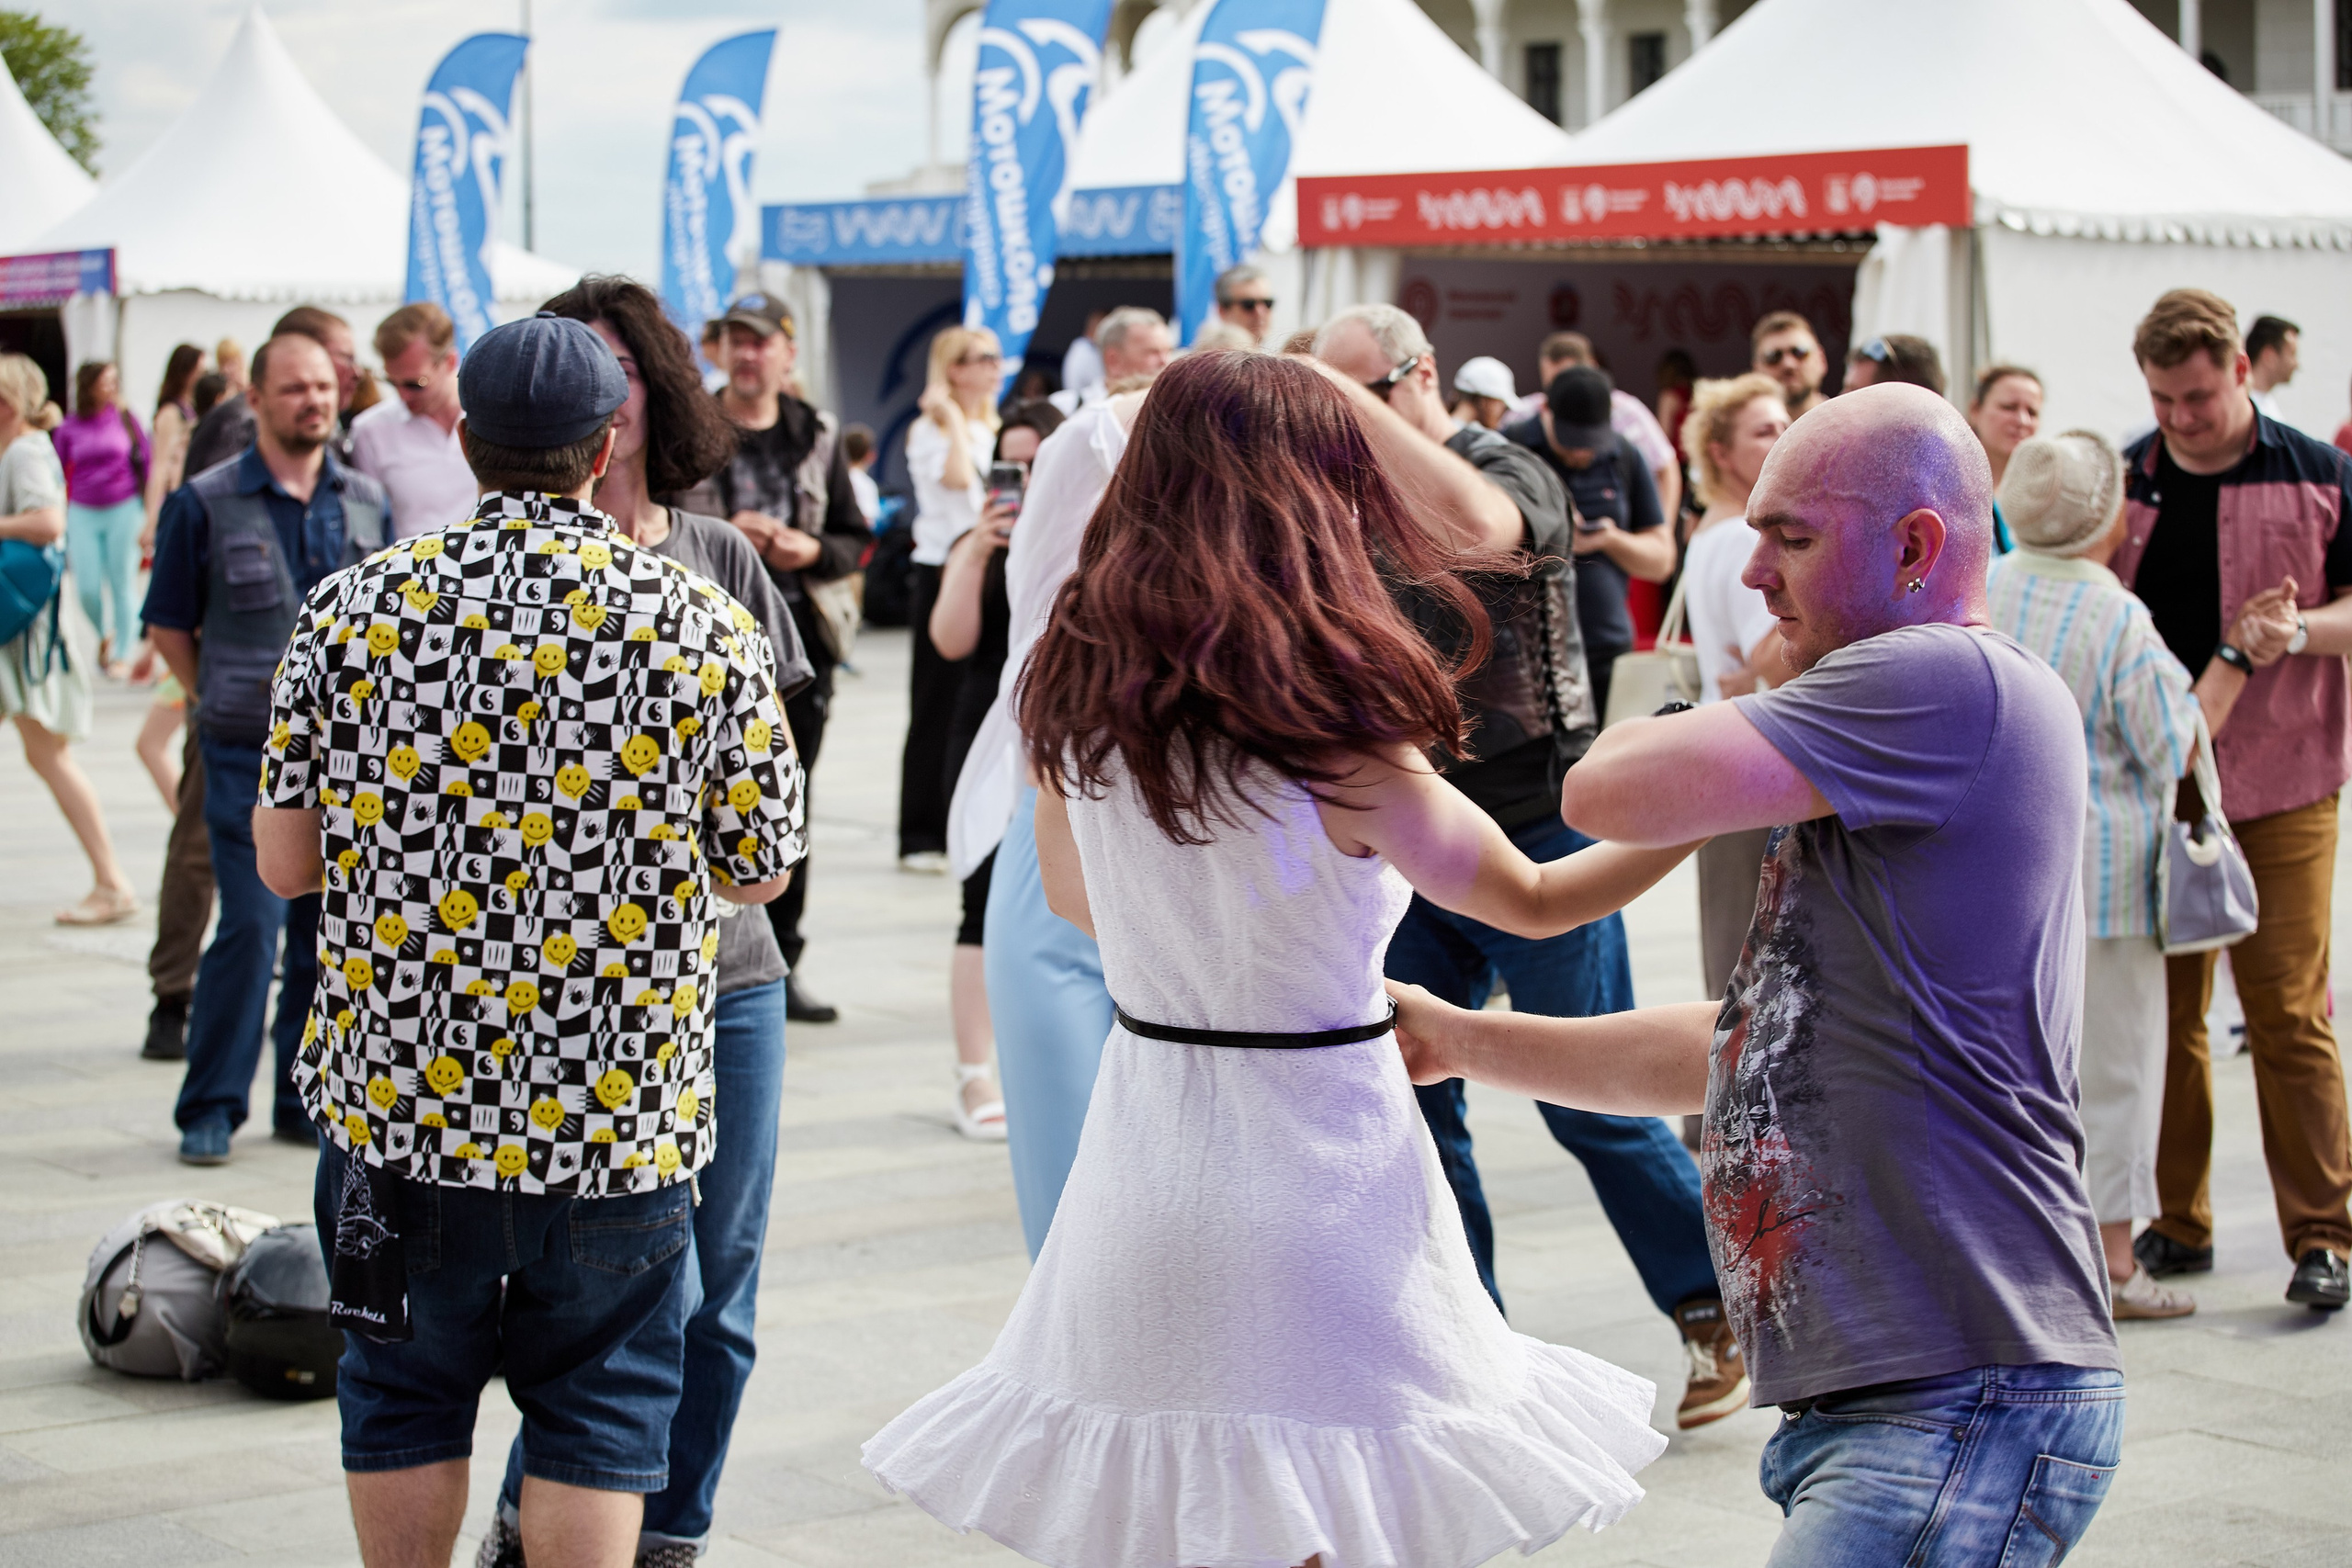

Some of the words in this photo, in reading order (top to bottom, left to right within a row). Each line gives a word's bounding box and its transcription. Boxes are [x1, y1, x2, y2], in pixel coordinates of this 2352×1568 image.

[421, 125, 487, 352] Мотошкол
[978, 67, 1038, 335] Мотошкола
[331, 1300, 387, 1324] Rockets
